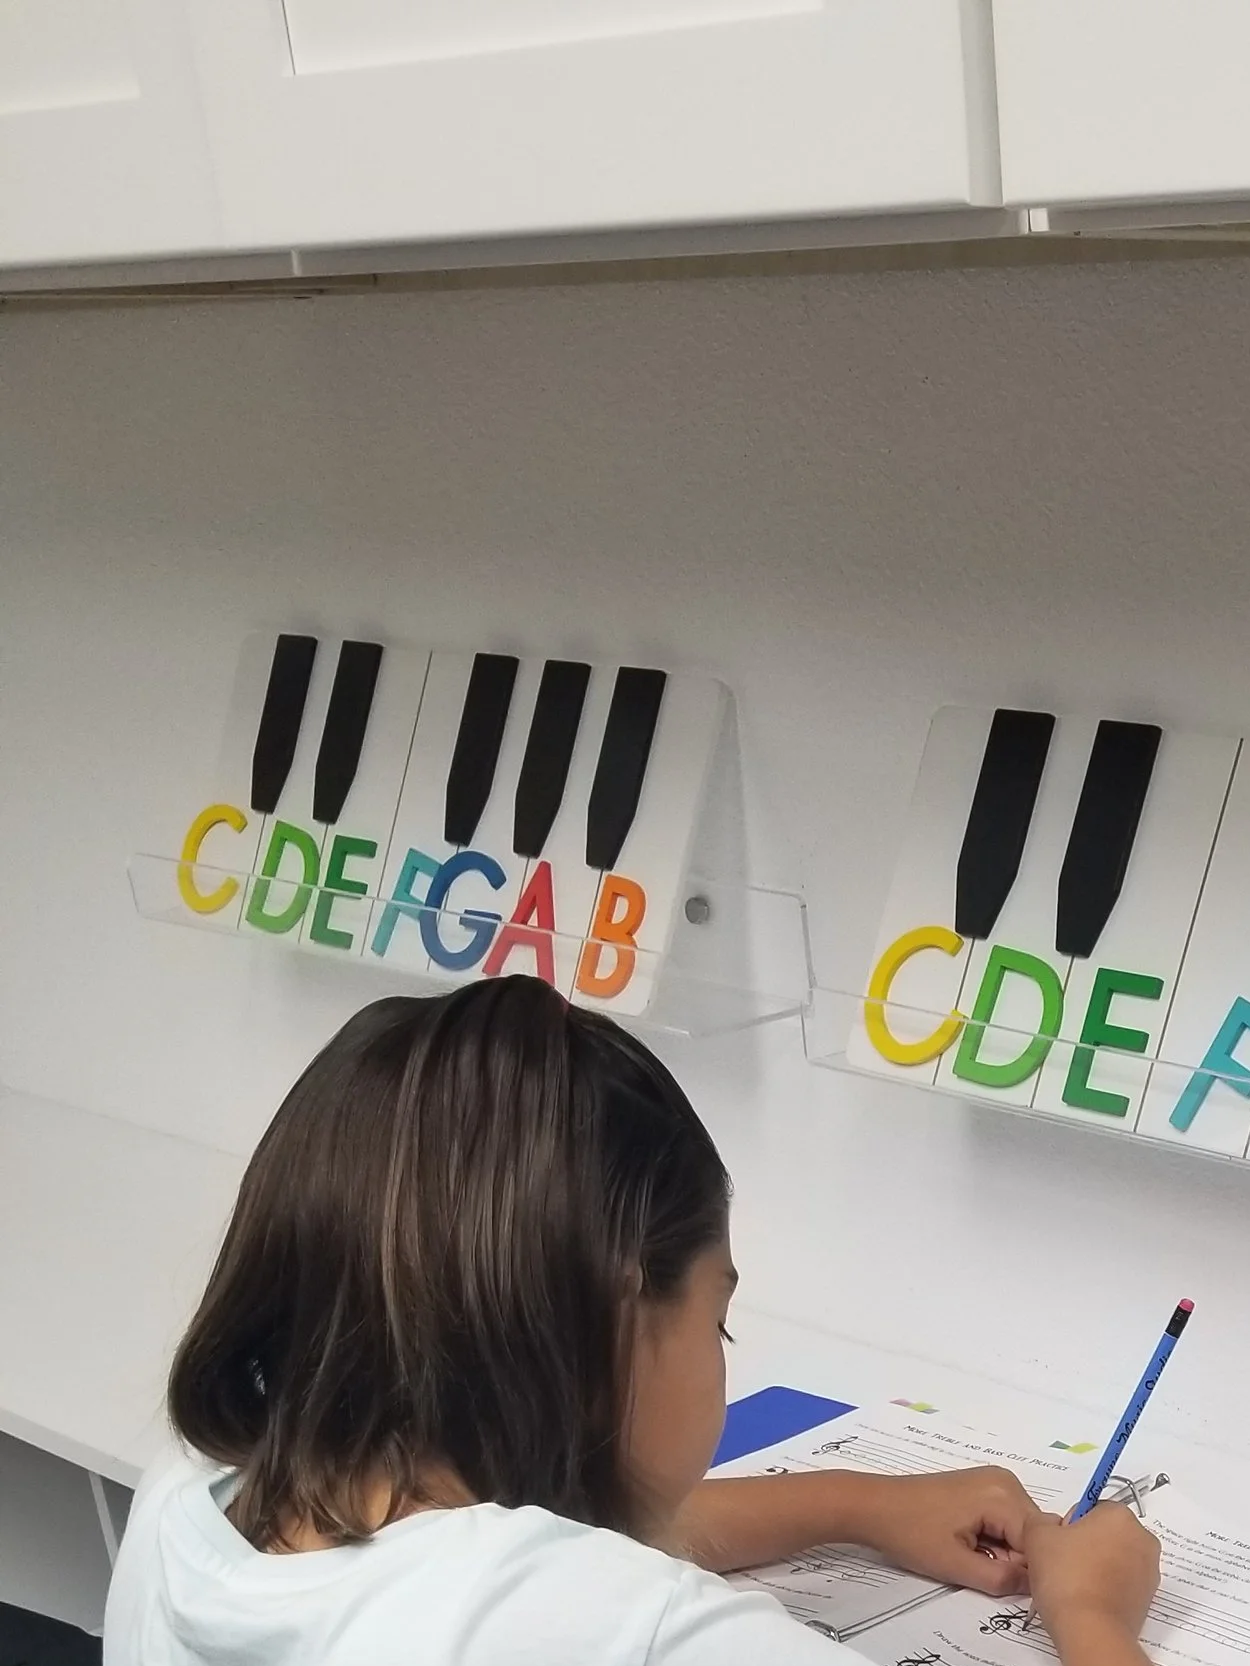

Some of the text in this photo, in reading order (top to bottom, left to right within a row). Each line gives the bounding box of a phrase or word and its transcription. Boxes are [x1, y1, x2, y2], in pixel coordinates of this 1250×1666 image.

[177, 804, 248, 915] C
[245, 820, 321, 934] D
[310, 834, 378, 950] E
[419, 850, 507, 971] G
[482, 860, 556, 988] A
[576, 873, 648, 998] B
[864, 926, 967, 1067] C
[952, 944, 1064, 1088] D
[1061, 967, 1165, 1118] E
